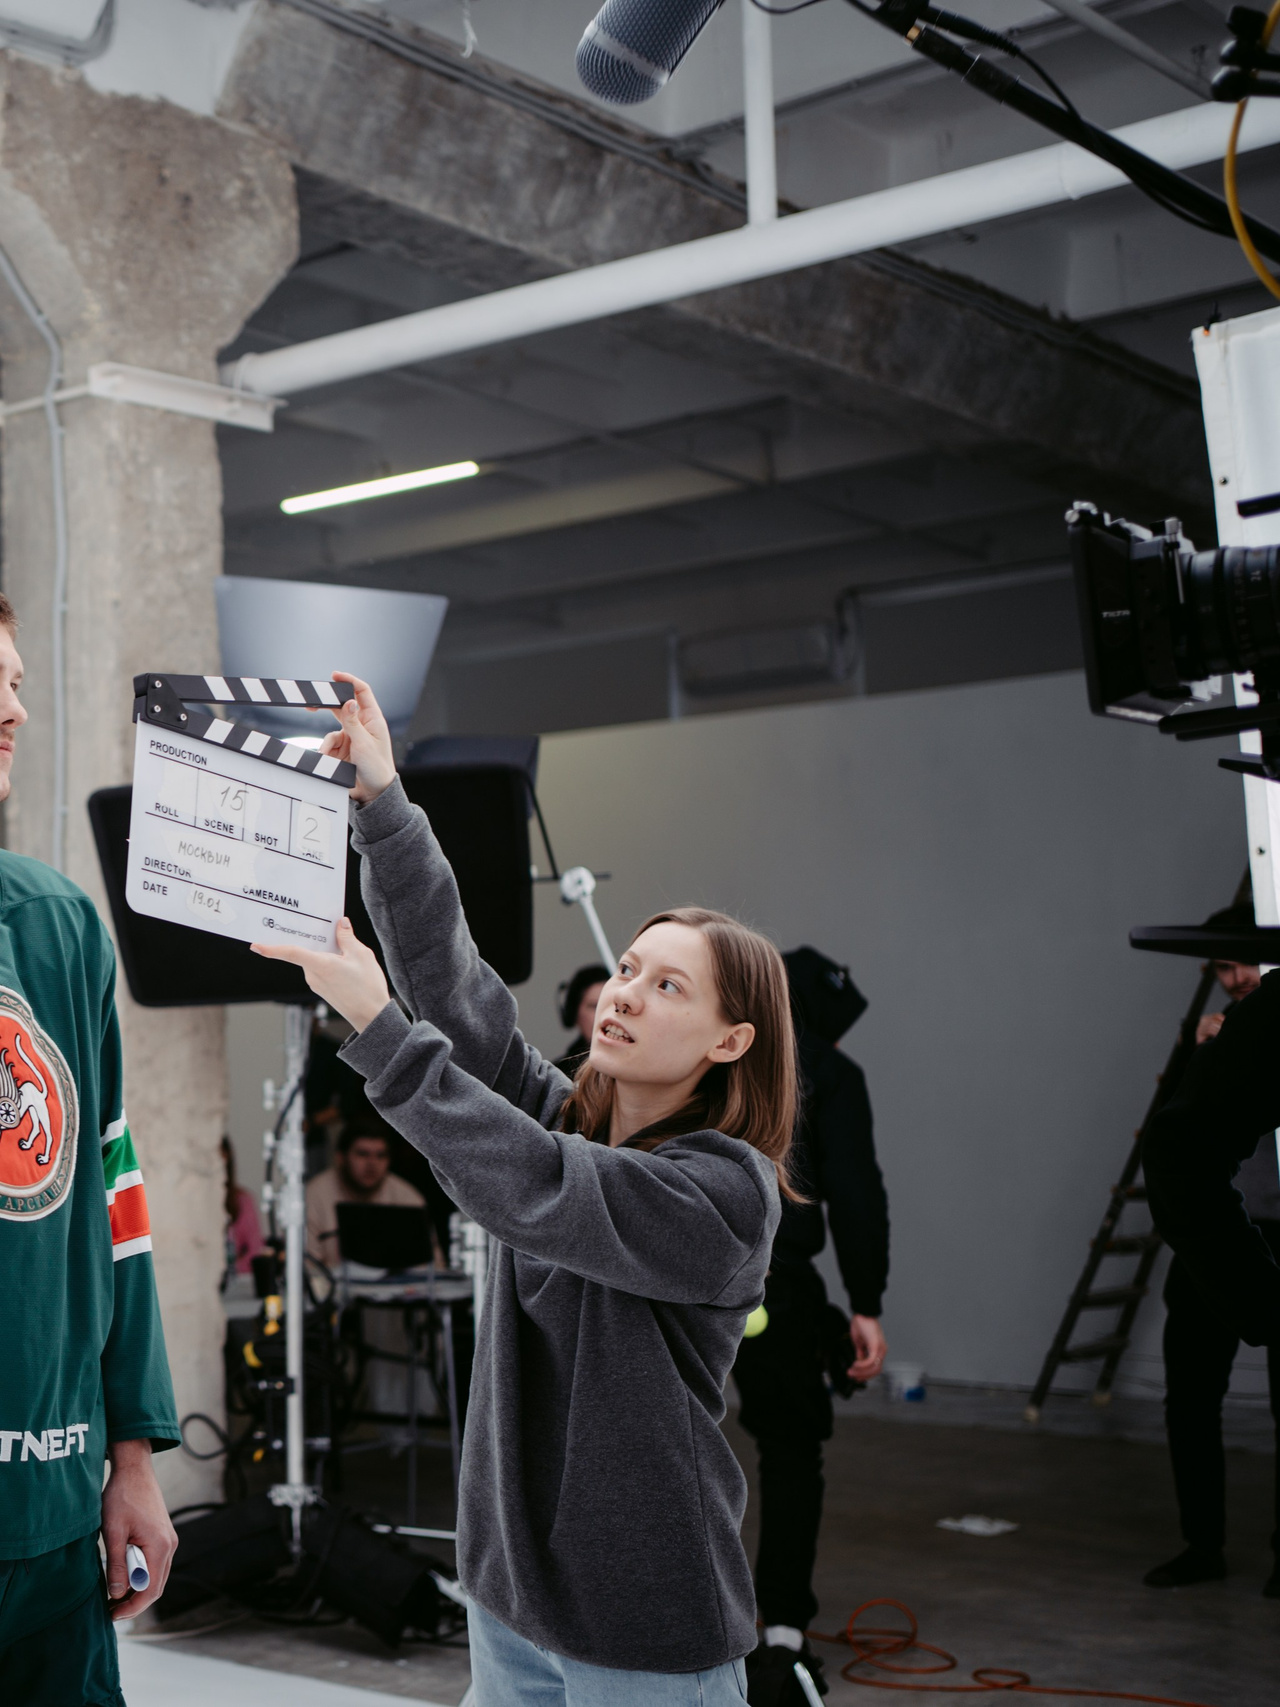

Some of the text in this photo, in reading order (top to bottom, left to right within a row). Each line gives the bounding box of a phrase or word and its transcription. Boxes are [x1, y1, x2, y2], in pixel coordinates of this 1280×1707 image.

[149, 739, 208, 766] PRODUCTION
[220, 785, 250, 812] 15
[154, 802, 180, 818] ROLL
[203, 819, 235, 835] SCENE
[254, 832, 279, 847] SHOT
[302, 816, 321, 843] 2
[142, 880, 168, 896] DATE
